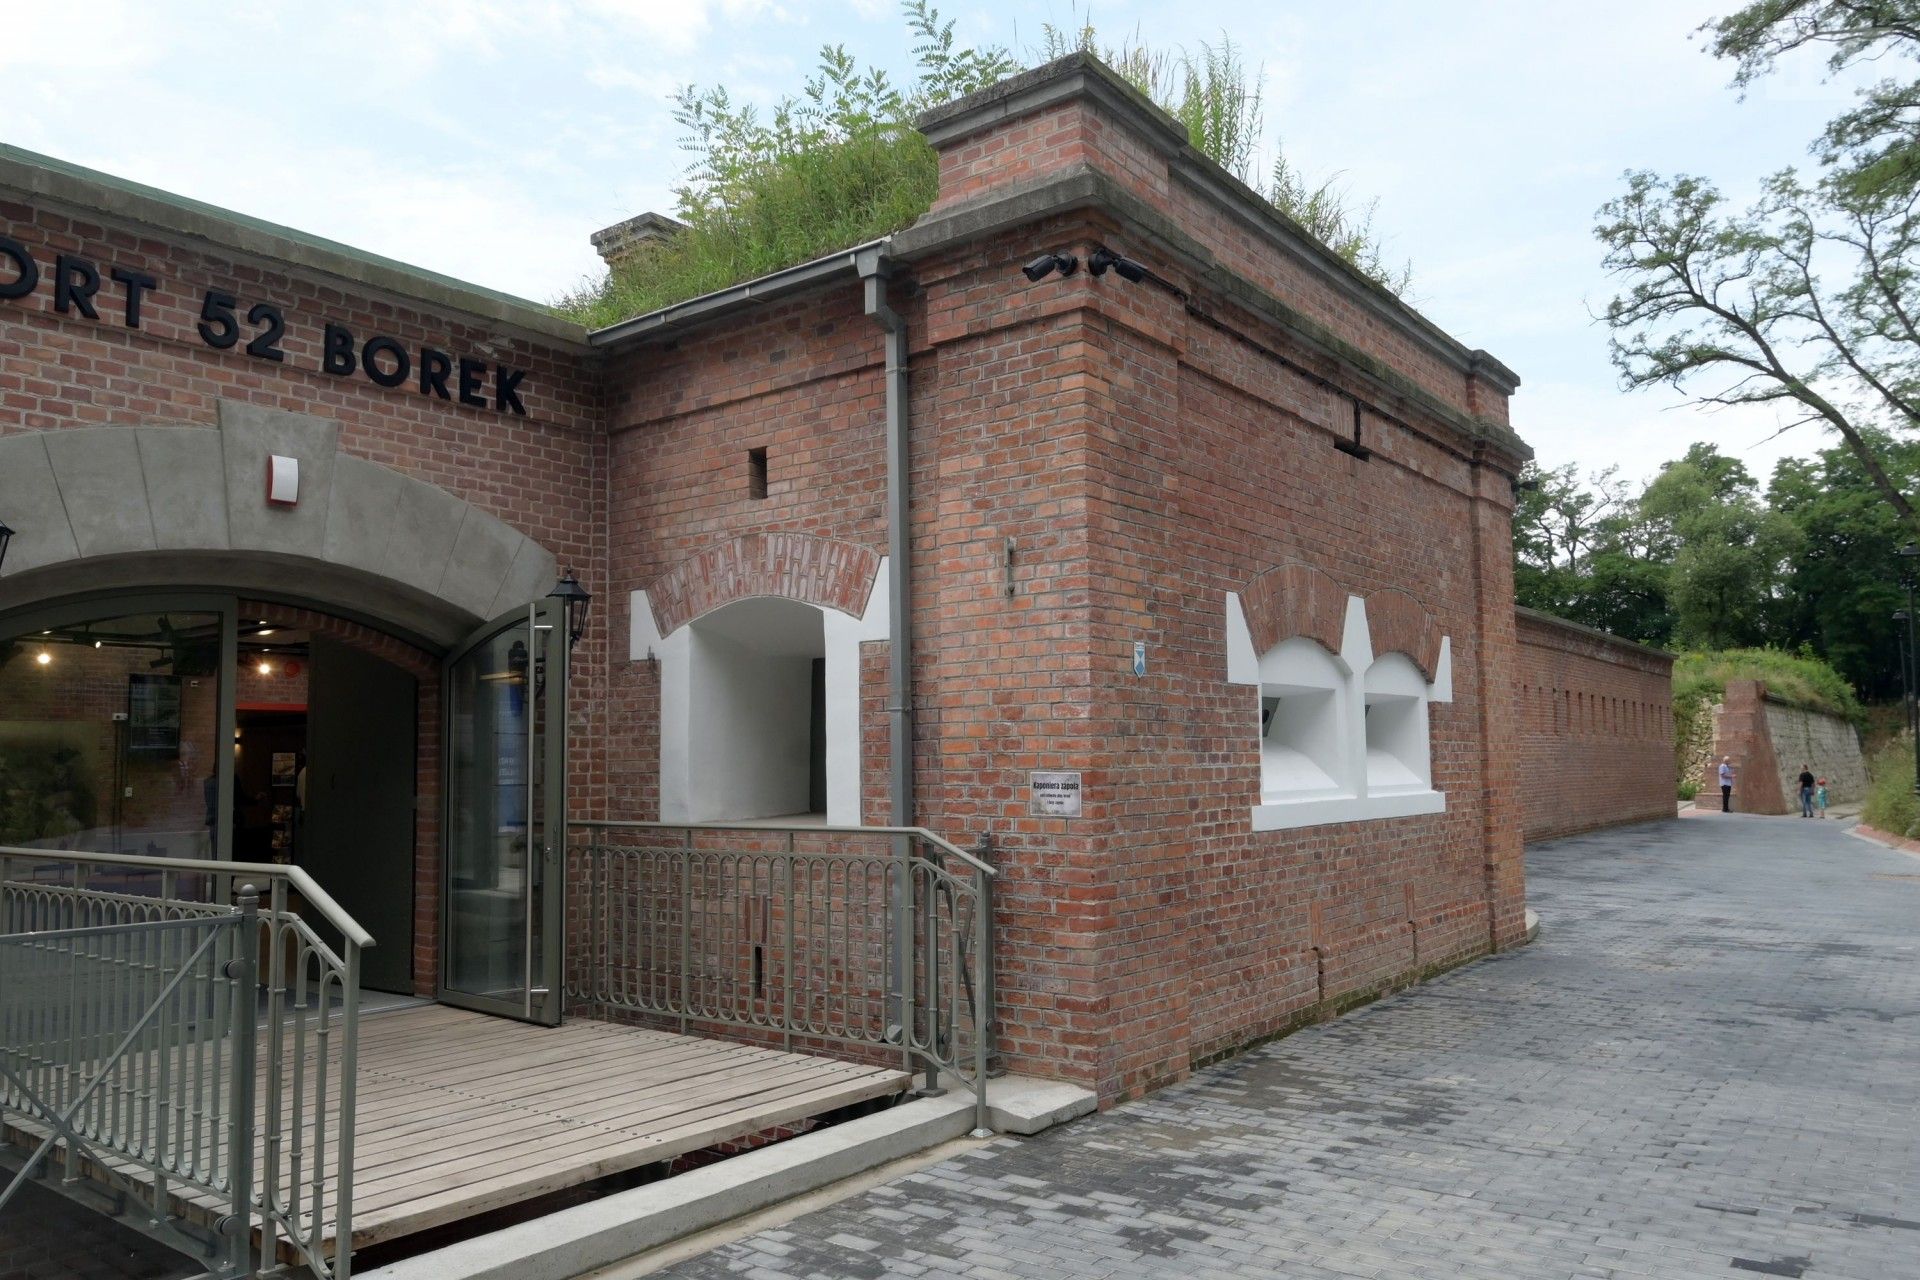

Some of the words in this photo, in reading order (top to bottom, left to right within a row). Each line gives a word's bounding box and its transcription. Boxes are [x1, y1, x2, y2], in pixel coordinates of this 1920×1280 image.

[197, 286, 286, 362] 52
[323, 323, 526, 416] BOREK
[1033, 781, 1060, 790] Kaponiera
